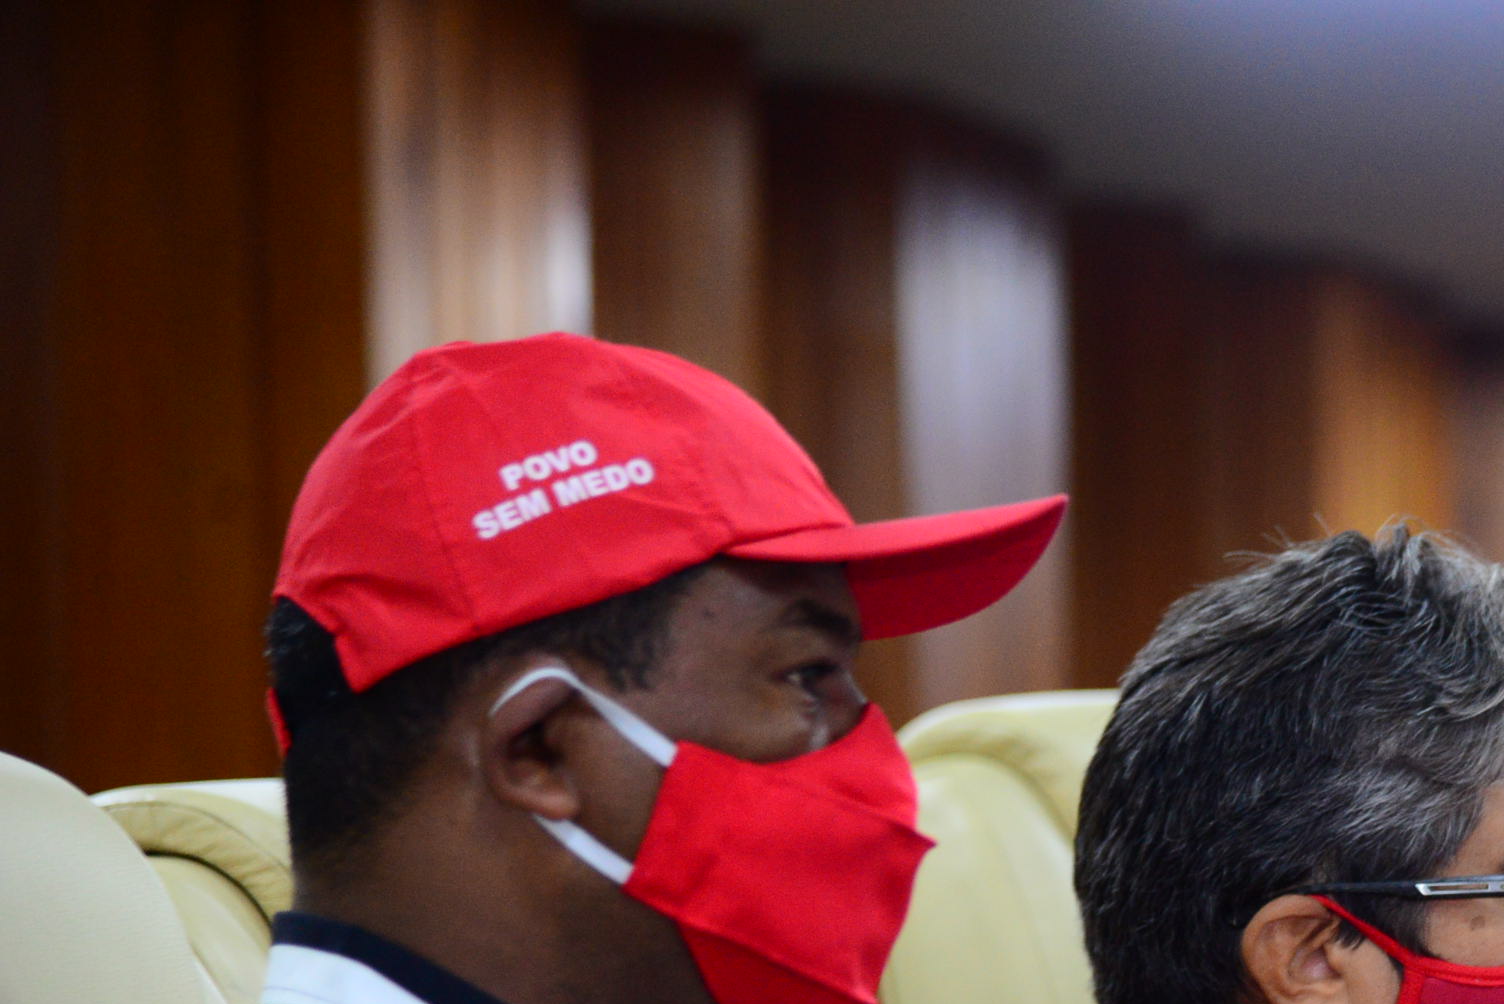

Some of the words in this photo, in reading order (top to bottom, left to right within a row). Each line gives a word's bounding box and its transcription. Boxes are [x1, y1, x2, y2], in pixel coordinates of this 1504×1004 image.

[472, 488, 552, 539] SEM
[552, 457, 655, 507] MEDO
[500, 440, 597, 490] POVO
